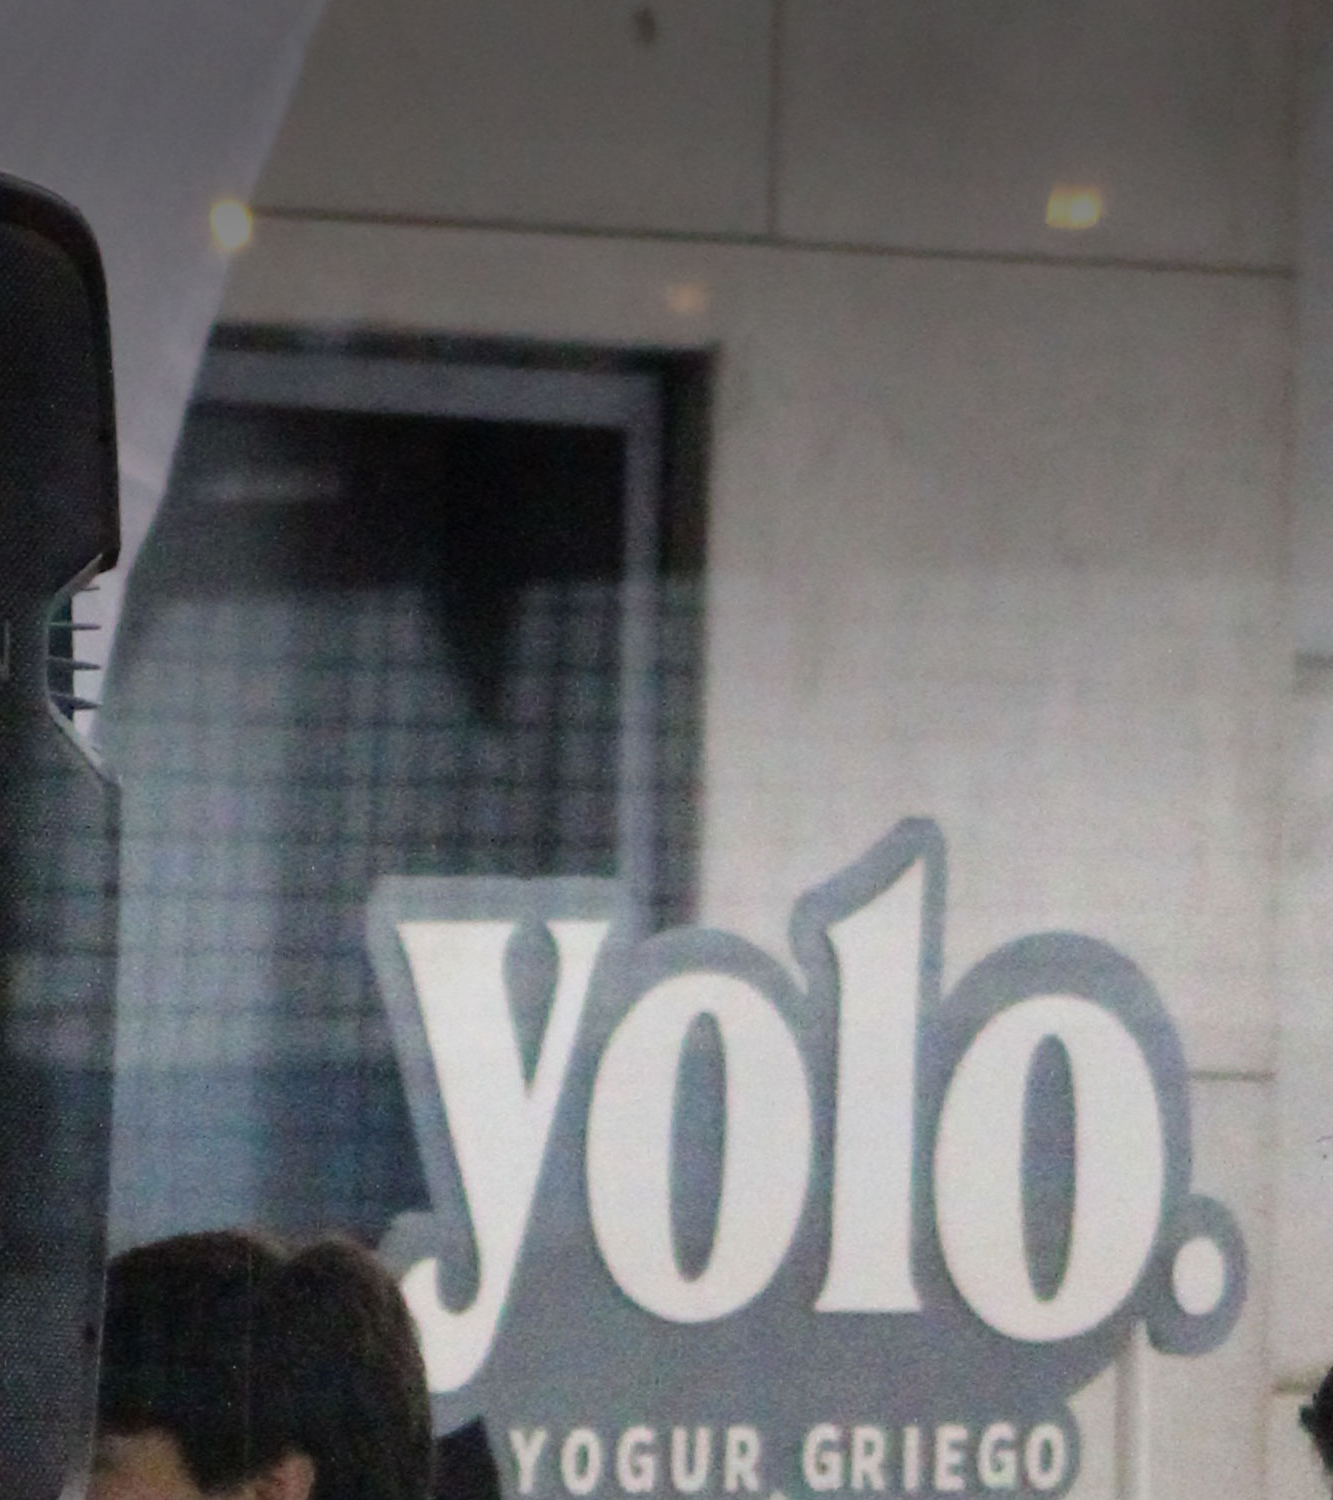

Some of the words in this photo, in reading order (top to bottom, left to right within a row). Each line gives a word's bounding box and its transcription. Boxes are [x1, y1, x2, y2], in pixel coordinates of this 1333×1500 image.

[396, 852, 1225, 1392] yolo.
[507, 1425, 761, 1494] YOGUR
[803, 1422, 1069, 1492] GRIEGO
